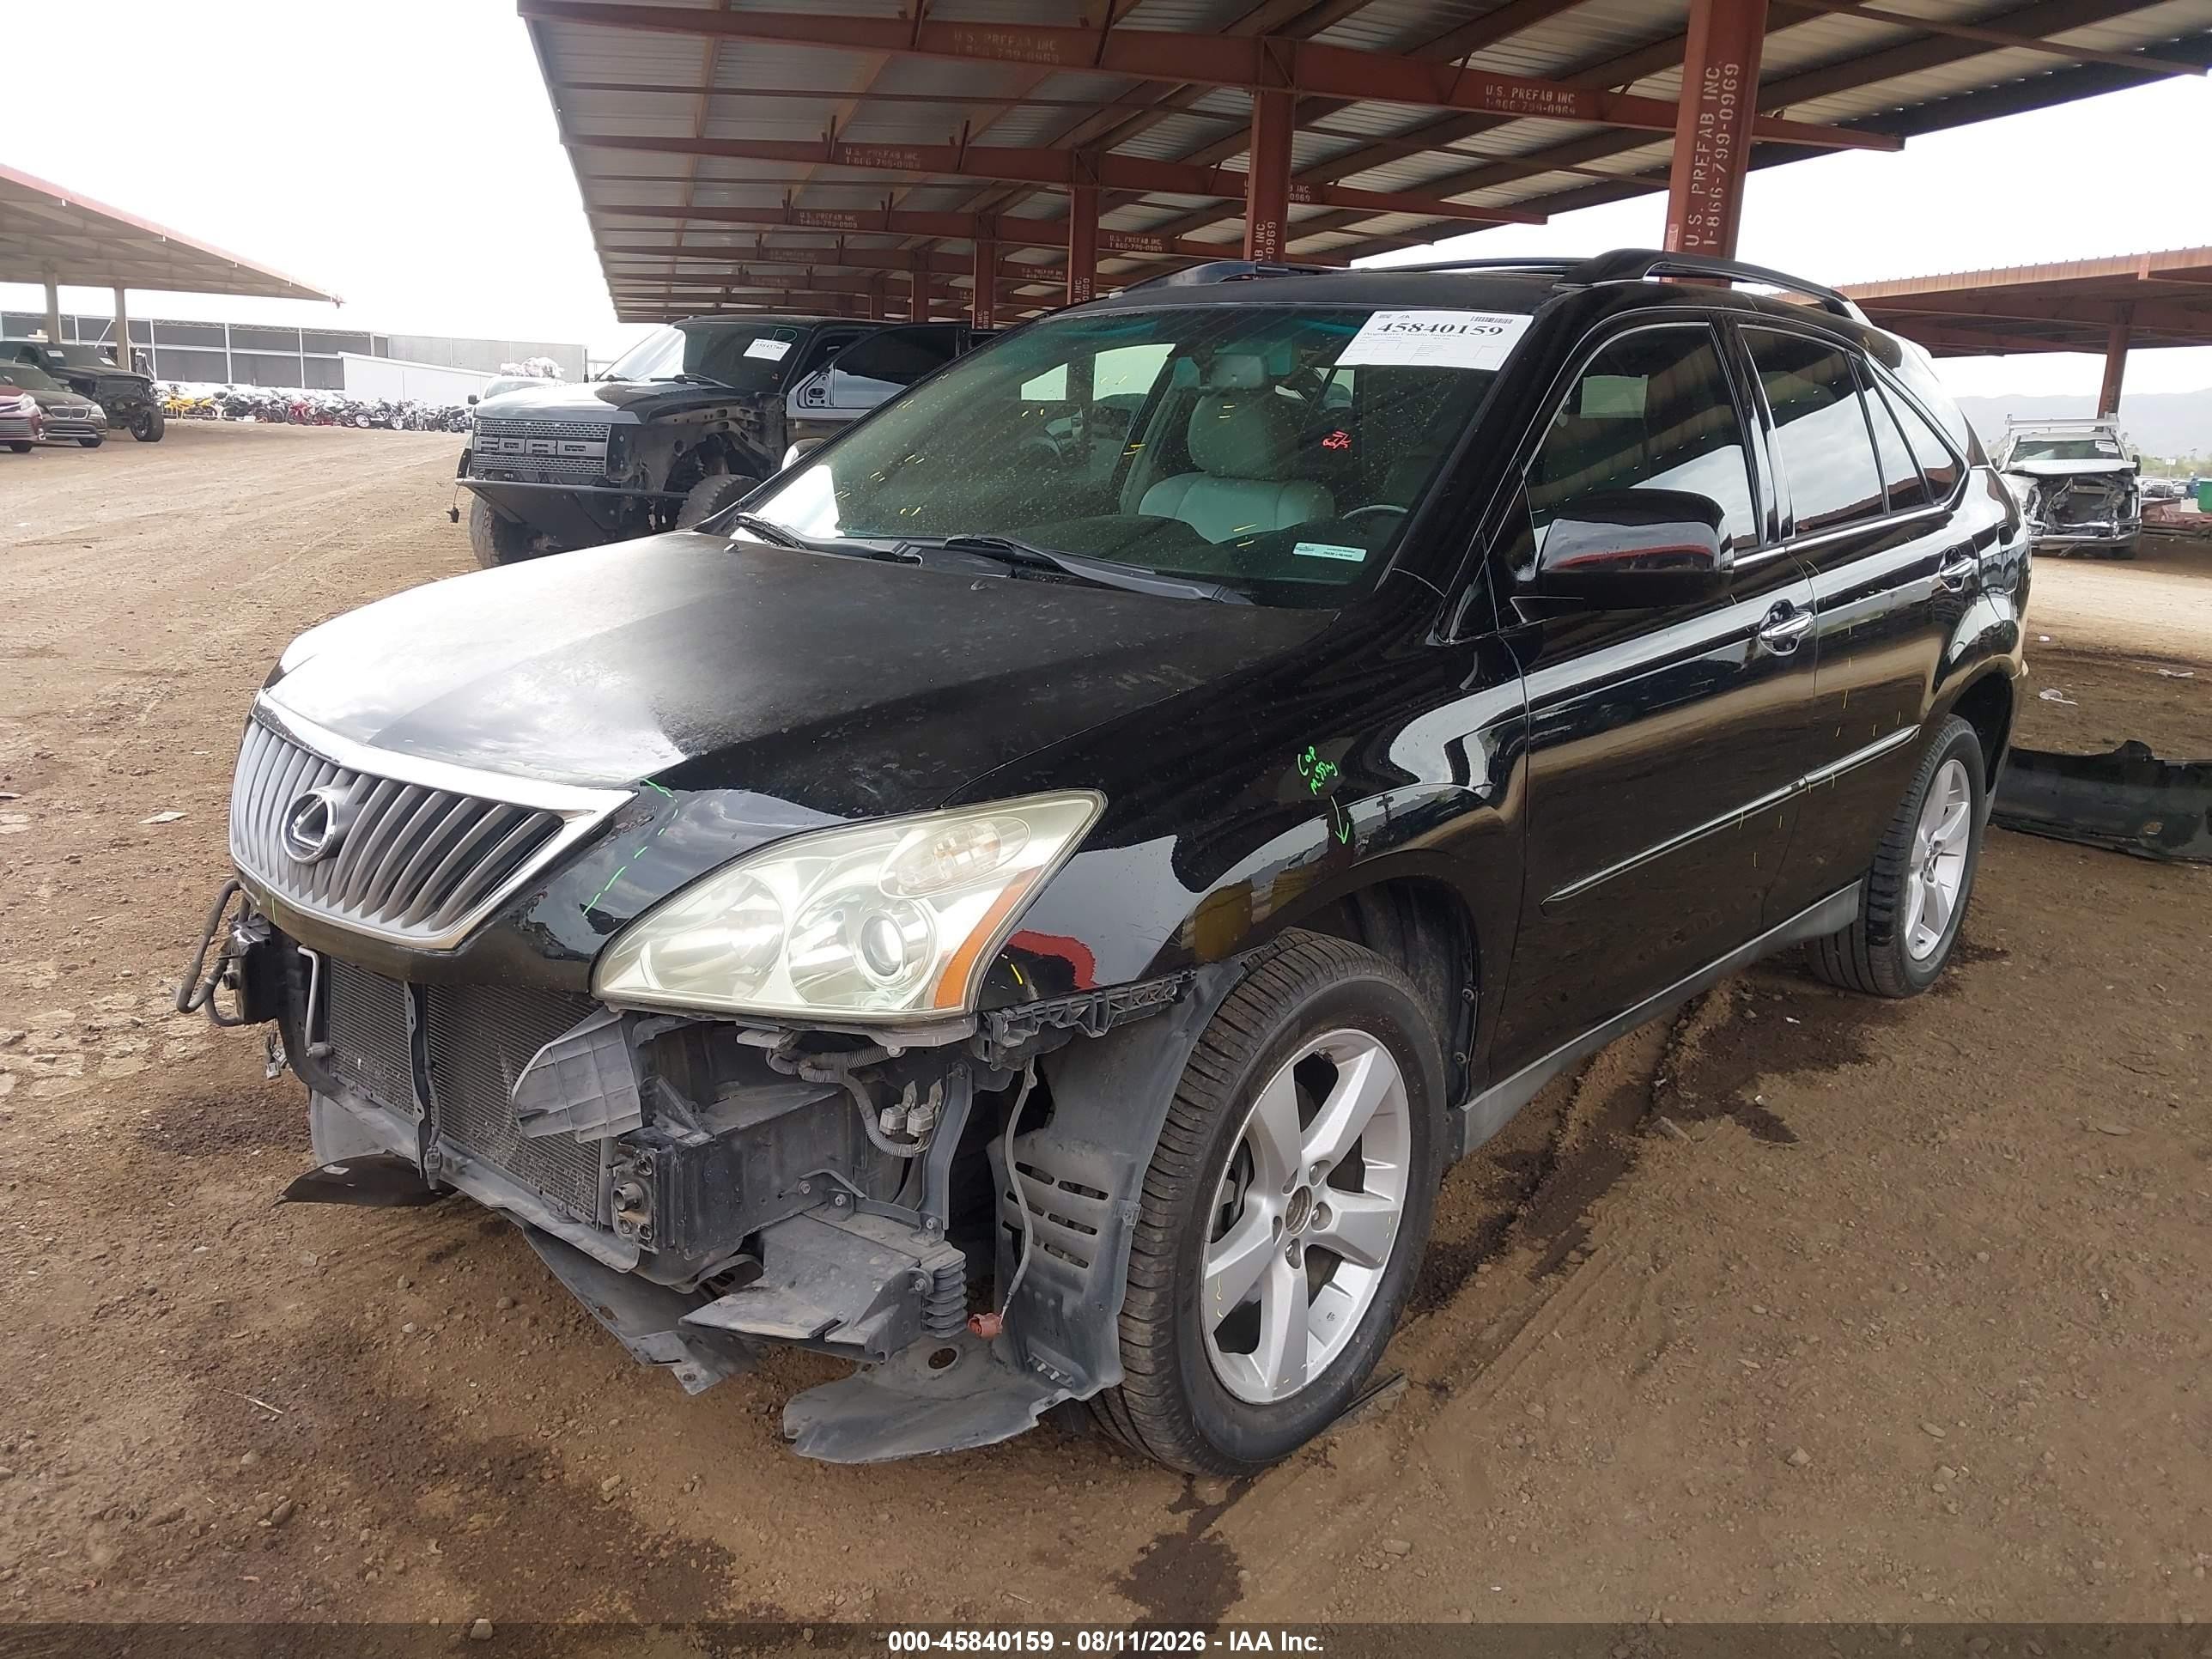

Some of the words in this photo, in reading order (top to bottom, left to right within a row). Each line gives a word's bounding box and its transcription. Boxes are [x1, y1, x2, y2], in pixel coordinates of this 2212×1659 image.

[1486, 85, 1505, 97] U.S.
[1511, 88, 1553, 101] PREFAB
[1691, 112, 1715, 194] PREFAB
[1703, 64, 1740, 246] 1-866-799-0969
[1685, 208, 1704, 246] U.S.
[1376, 322, 1504, 337] 45840159
[474, 436, 607, 457] FORD
